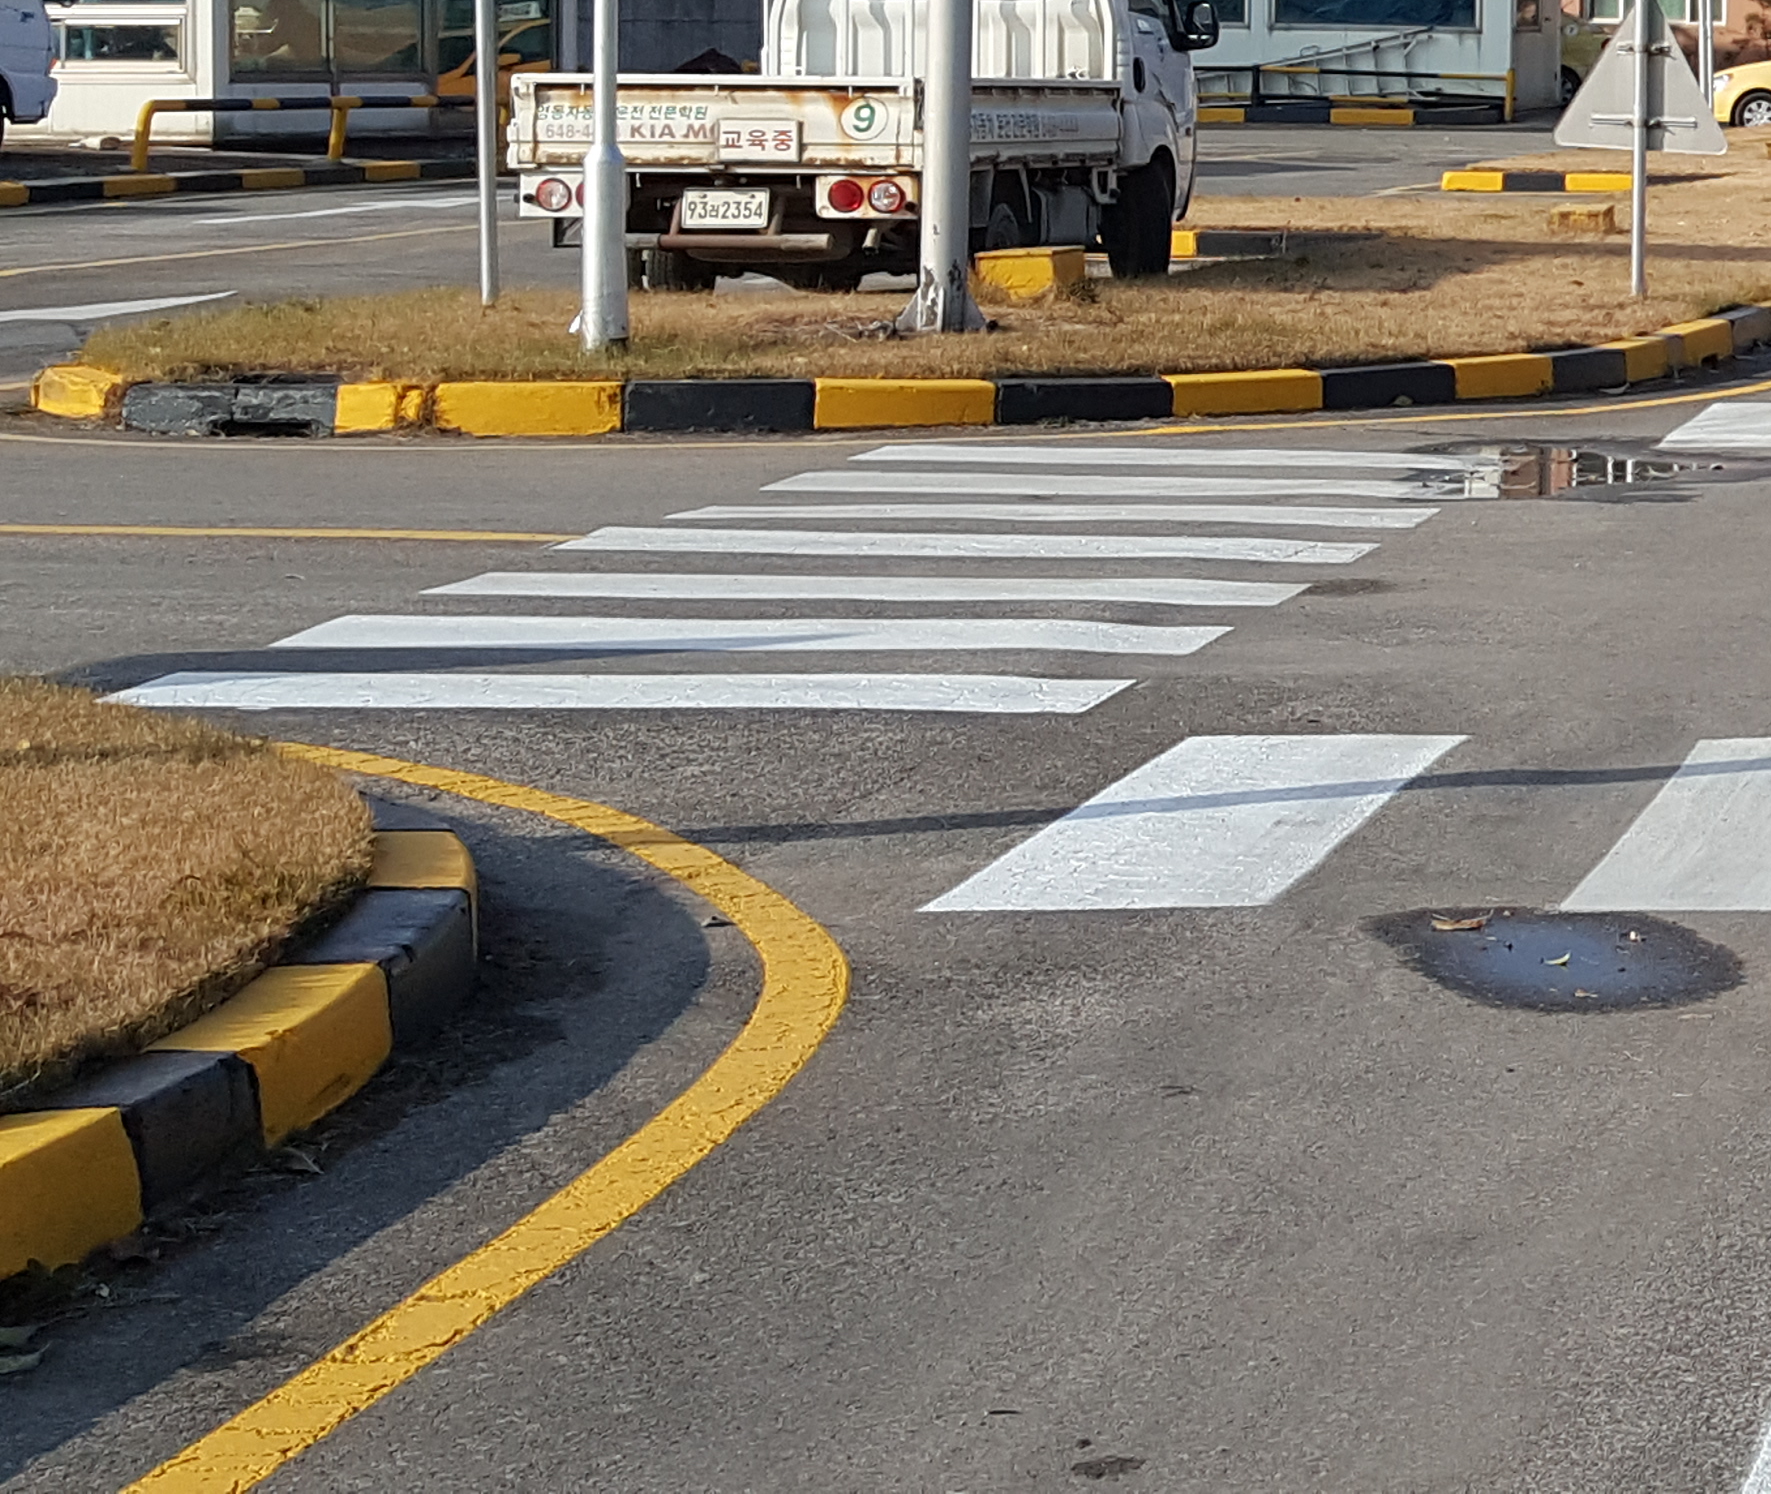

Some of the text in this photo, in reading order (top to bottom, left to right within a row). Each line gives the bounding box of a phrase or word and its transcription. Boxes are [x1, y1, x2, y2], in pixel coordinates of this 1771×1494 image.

[536, 104, 595, 121] 영동자동
[649, 105, 709, 121] 전문학원
[545, 123, 596, 139] 648-4
[630, 123, 676, 139] KIA
[722, 128, 794, 152] 교육중
